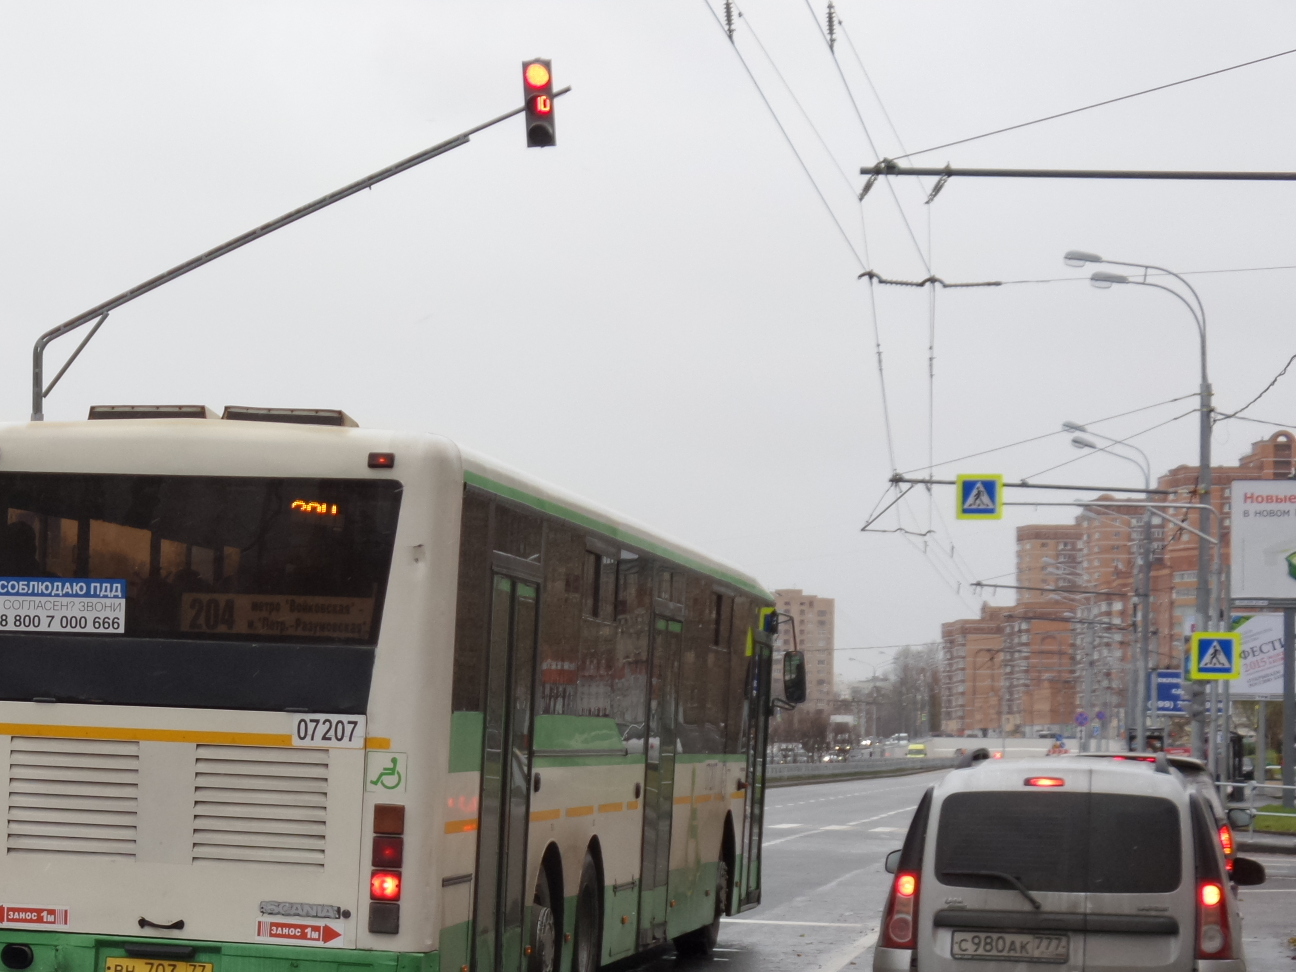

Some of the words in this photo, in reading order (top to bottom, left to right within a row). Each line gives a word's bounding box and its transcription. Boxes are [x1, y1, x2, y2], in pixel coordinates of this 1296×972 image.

[1243, 493, 1296, 504] Новые
[1243, 509, 1250, 518] в
[1254, 509, 1290, 518] новом
[90, 583, 122, 598] ПДД
[3, 600, 76, 611] СОГЛАСЕН?
[78, 602, 122, 612] ЗВОНИ
[250, 601, 281, 614] метро
[188, 598, 236, 632] 204
[0, 614, 8, 627] 8
[13, 614, 41, 628] 800
[46, 615, 54, 628] 7
[59, 616, 88, 629] 000
[92, 617, 121, 630] 666
[1147, 700, 1174, 709] (99)
[297, 718, 358, 742] 07207
[7, 911, 38, 920] ЗАНОС
[264, 902, 339, 918] SCANIA
[271, 926, 302, 936] ЗАНОС
